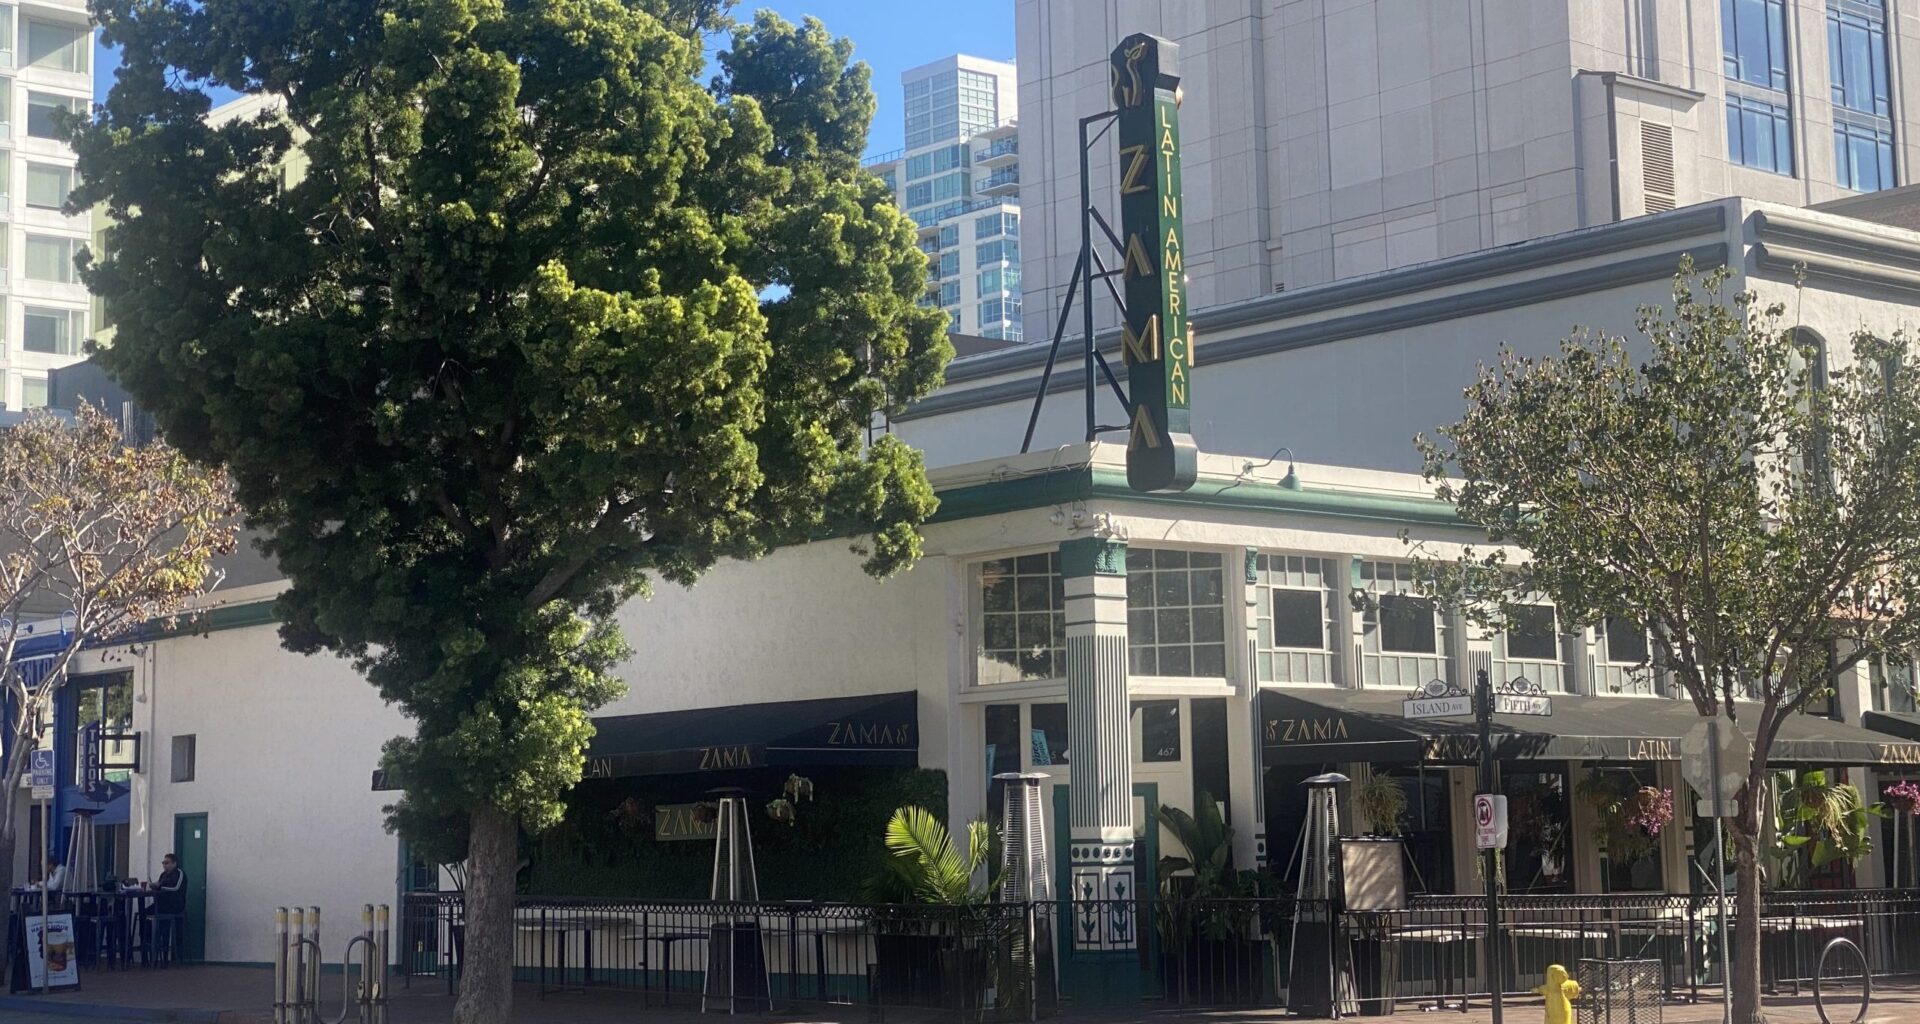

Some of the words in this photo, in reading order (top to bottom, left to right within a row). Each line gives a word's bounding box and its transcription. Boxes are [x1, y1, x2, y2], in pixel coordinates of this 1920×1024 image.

[1161, 105, 1178, 219] LATIN
[1119, 144, 1162, 452] ZAMA
[1164, 227, 1185, 406] AMERICAN
[1412, 701, 1450, 715] ISLAND
[1504, 697, 1531, 713] FIFTH
[826, 722, 894, 745] ZAMA
[1281, 717, 1349, 742] ZAMA
[88, 729, 97, 792] TACOS
[699, 746, 752, 770] ZAMA
[1157, 748, 1174, 757] 467
[1627, 740, 1672, 760] LATIN
